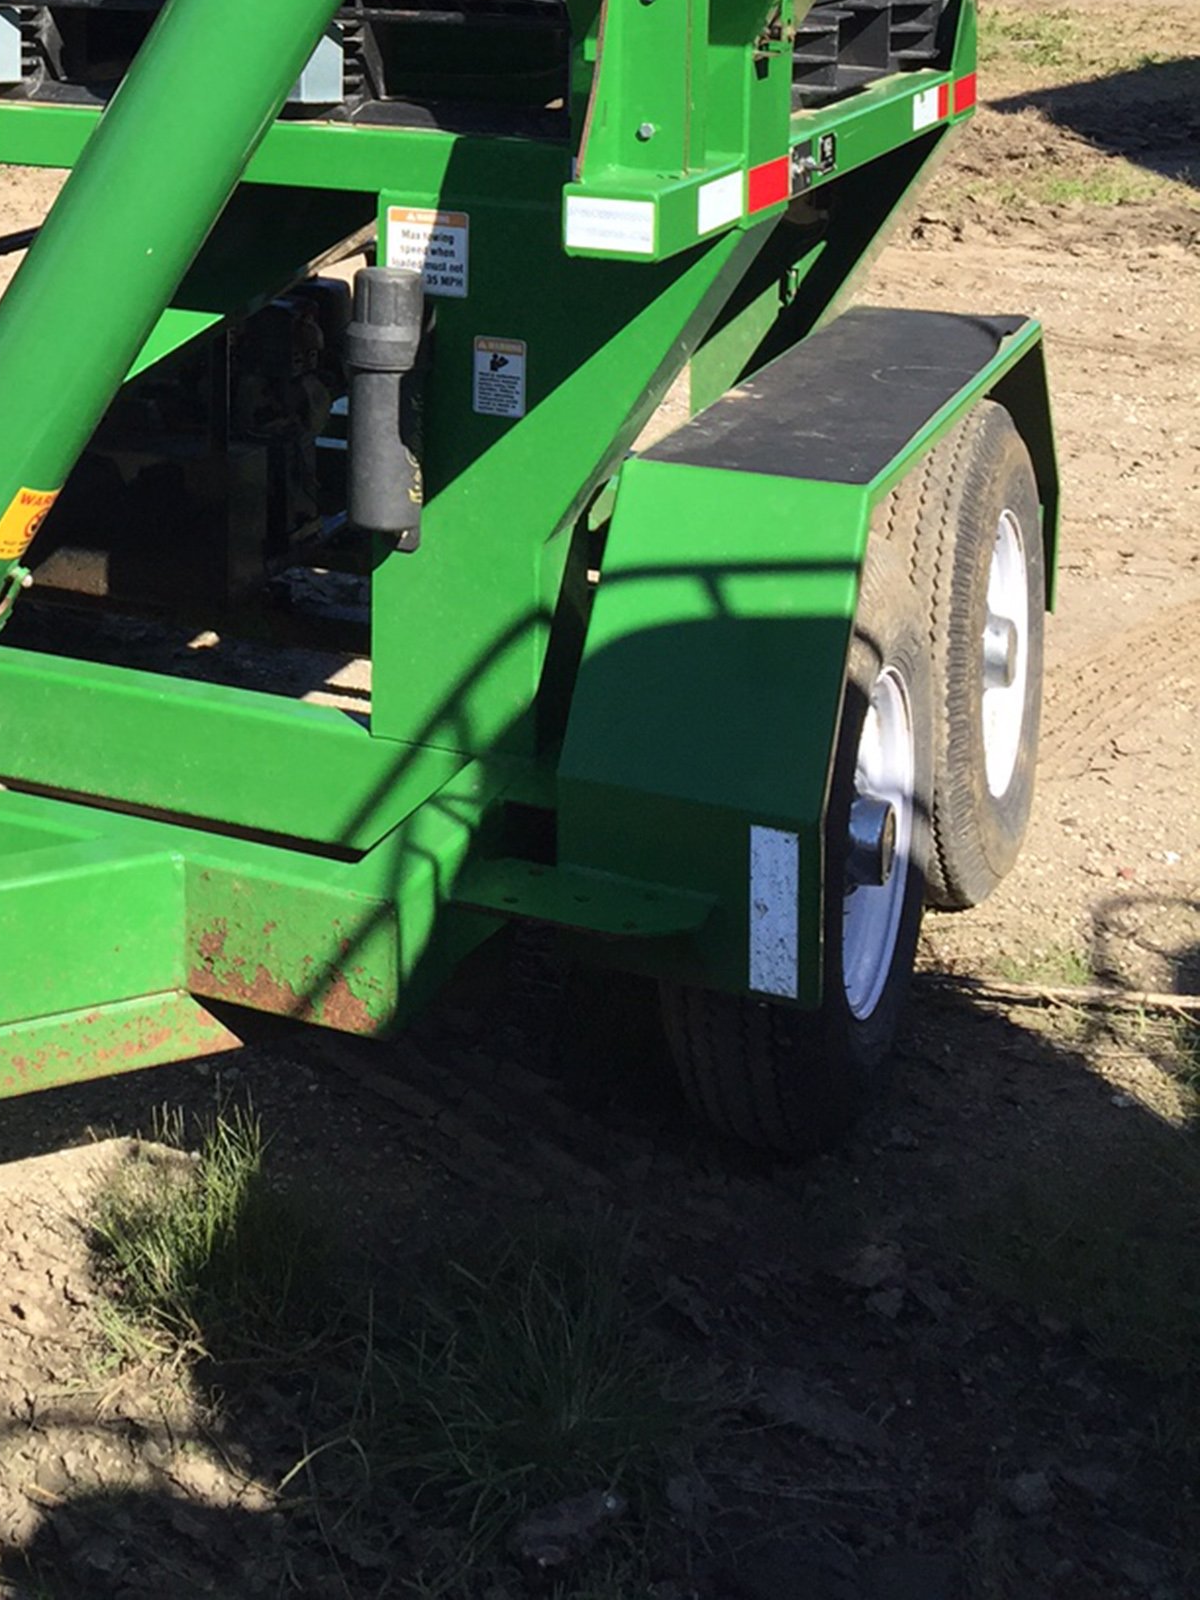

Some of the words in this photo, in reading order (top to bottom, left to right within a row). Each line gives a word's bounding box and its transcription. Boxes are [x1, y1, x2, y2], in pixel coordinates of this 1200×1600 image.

[430, 247, 456, 259] when
[424, 261, 447, 272] must
[449, 263, 464, 274] not
[426, 274, 439, 285] 35
[440, 276, 464, 287] MPH
